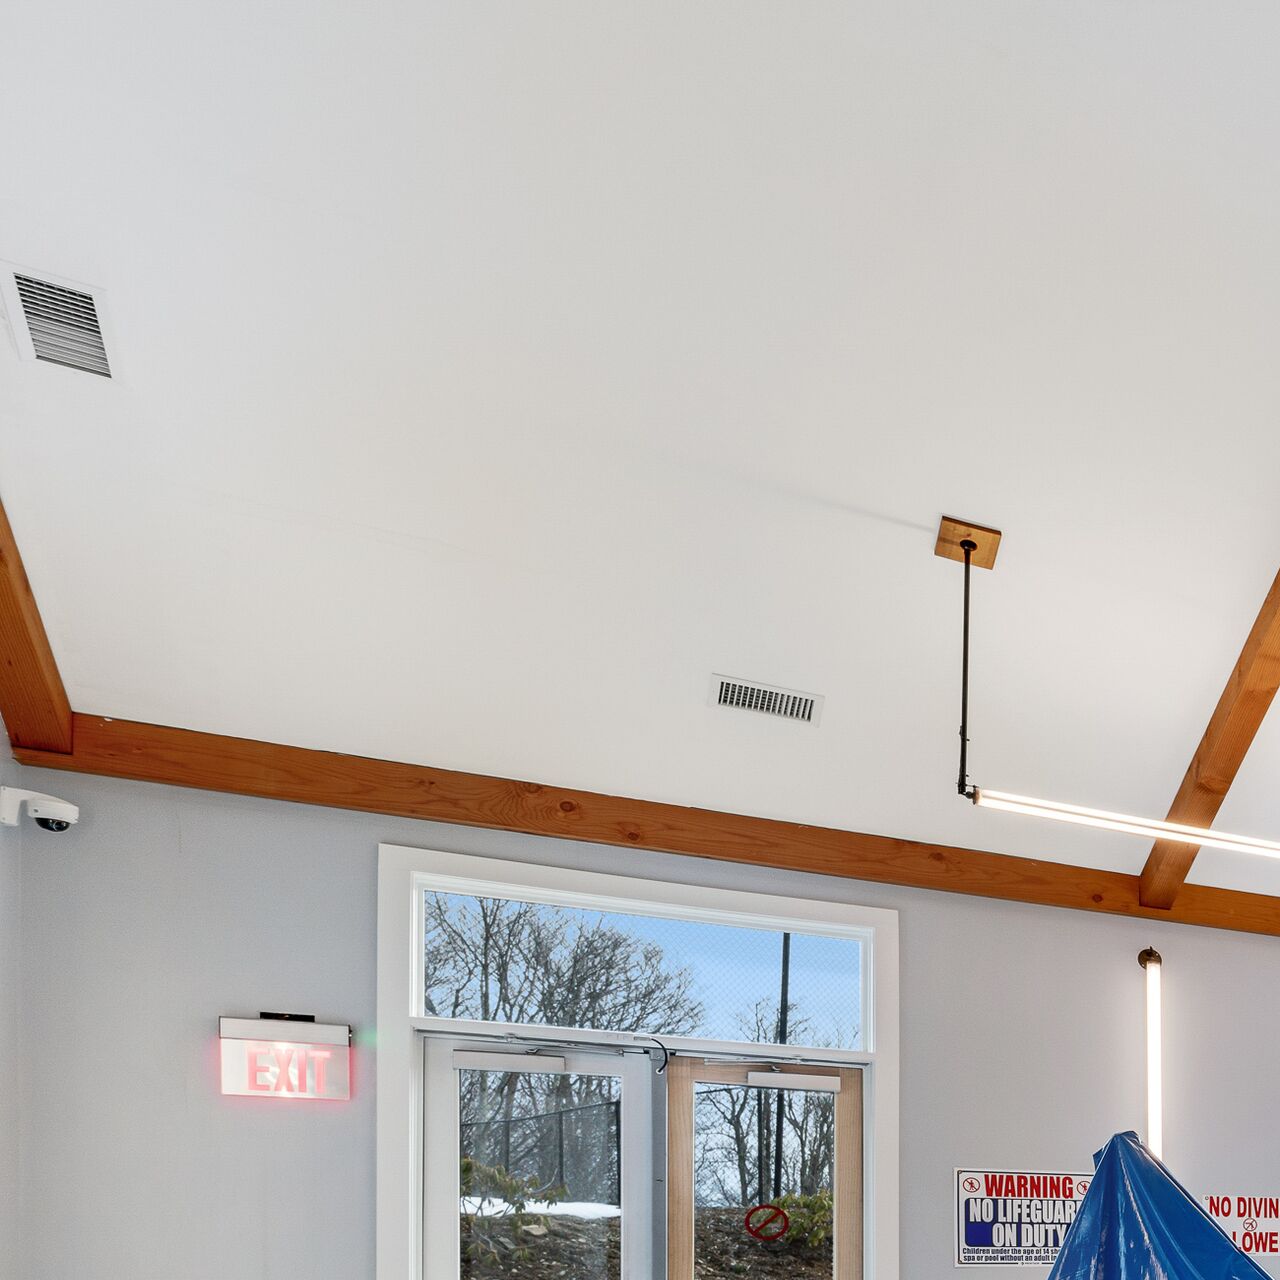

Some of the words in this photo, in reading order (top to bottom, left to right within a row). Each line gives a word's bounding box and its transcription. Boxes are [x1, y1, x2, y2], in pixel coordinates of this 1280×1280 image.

[247, 1049, 333, 1094] EXIT
[984, 1174, 1074, 1199] WARNING
[969, 1199, 993, 1222] NO
[998, 1199, 1082, 1223] LIFEGUAR
[1209, 1196, 1231, 1217] NO
[992, 1223, 1017, 1247] ON
[1021, 1224, 1066, 1247] DUTY
[962, 1247, 990, 1255] Children
[1000, 1254, 1024, 1262] without
